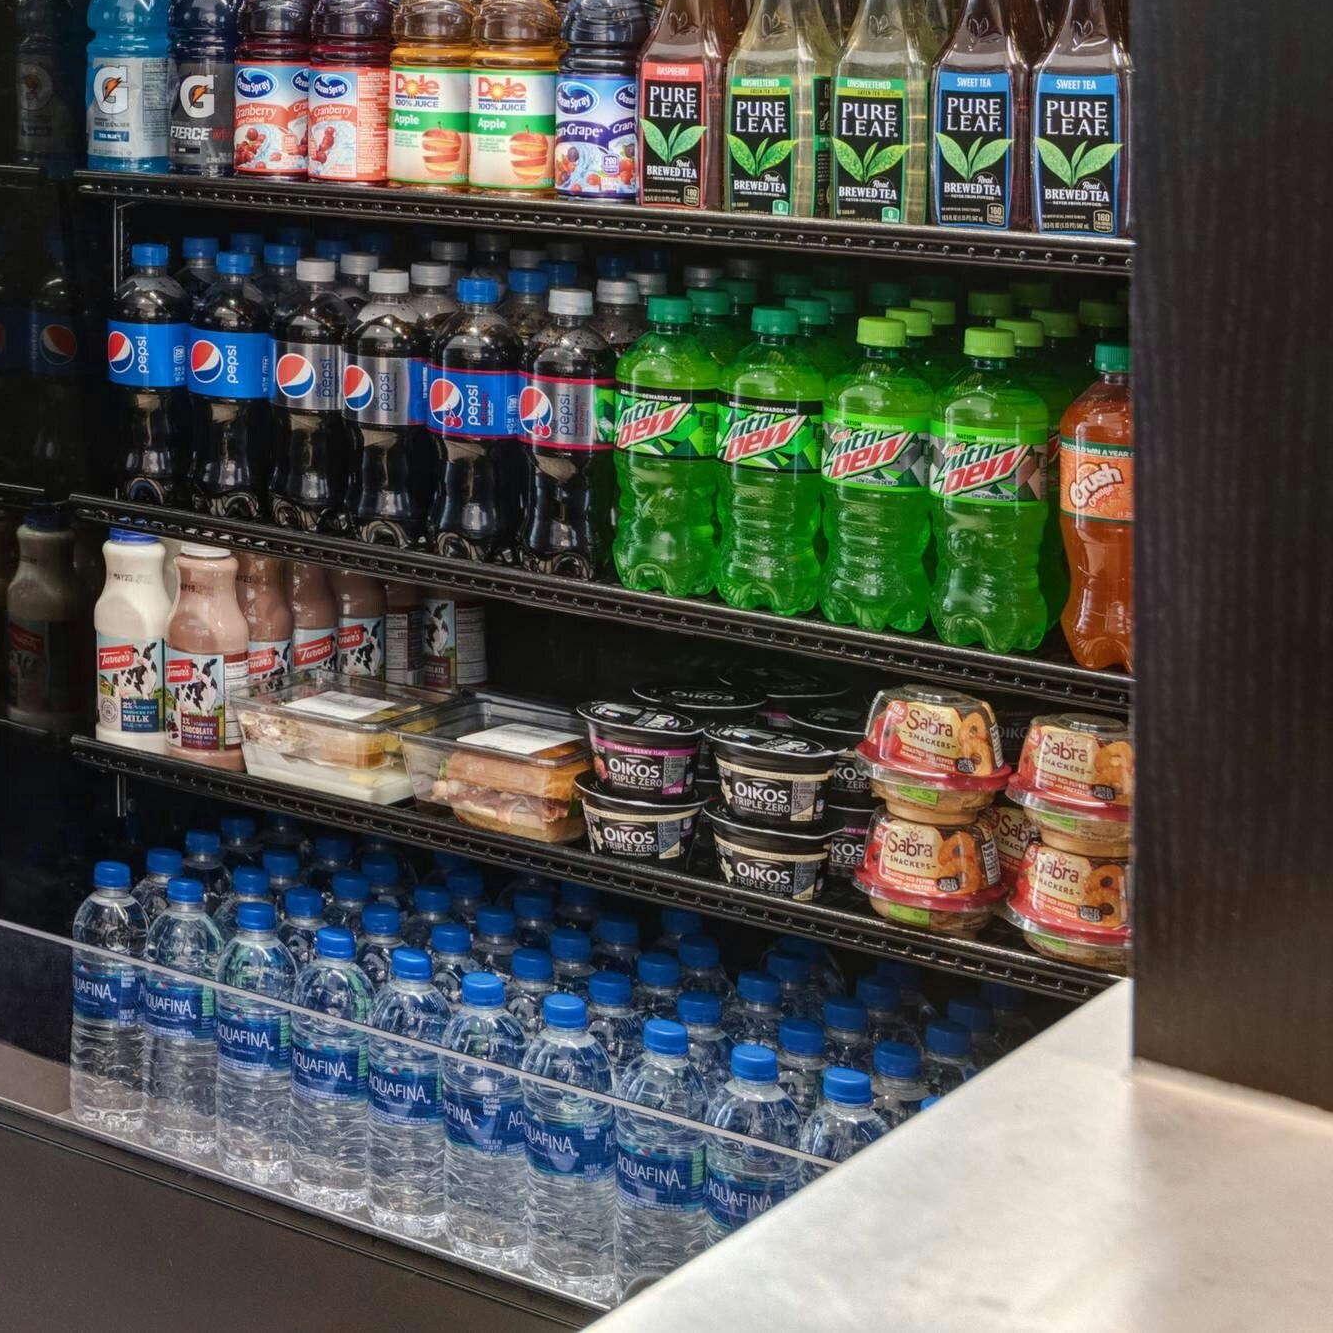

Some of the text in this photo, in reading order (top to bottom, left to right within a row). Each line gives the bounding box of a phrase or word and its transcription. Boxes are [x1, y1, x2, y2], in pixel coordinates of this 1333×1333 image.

[93, 64, 129, 115] G
[395, 73, 440, 96] Dole
[477, 76, 527, 99] Dole
[956, 78, 992, 88] SWEET TEA
[1056, 79, 1097, 91] SWEET TEA
[180, 74, 215, 119] G
[414, 99, 440, 108] JUICE
[649, 86, 697, 103] PURE
[235, 104, 277, 121] Cranberry
[313, 104, 352, 119] Cranberry
[498, 102, 526, 112] JUICE
[736, 100, 786, 117] PURE
[841, 102, 898, 120] PURE
[947, 98, 1001, 114] PURE
[1046, 100, 1108, 118] PURE
[394, 112, 420, 127] Apple
[477, 117, 507, 131] Apple
[170, 125, 210, 141] FIERCE
[646, 165, 698, 179] BREWED TEA
[733, 179, 787, 194] BREWED TEA
[838, 185, 898, 200] BREWED TEA
[943, 182, 1002, 196] BREWED TEA
[1044, 188, 1110, 203] BREWED TEA
[135, 336, 148, 374] pepsi
[225, 345, 239, 384] pepsi
[321, 359, 333, 398] pepsi
[380, 371, 391, 412] pepsi
[466, 384, 479, 426] pepsi
[558, 393, 571, 435] pepsi
[620, 402, 656, 427] Mtn
[730, 414, 772, 441] Mtn
[833, 431, 876, 459] Mtn
[947, 443, 993, 467] Mtn
[100, 650, 134, 667] Turner's
[300, 643, 335, 663] Turner's
[122, 714, 150, 724] MILK
[906, 708, 954, 737] Sabra
[181, 725, 214, 736] CHOCOLATE
[908, 731, 951, 750] SNACKERS
[1043, 734, 1089, 764] Sabra
[608, 757, 661, 779] OIKOS
[608, 772, 663, 789] TRIPLE ZERO
[735, 781, 789, 805] OIKOS
[734, 795, 791, 814] TRIPLE ZERO
[604, 823, 656, 845] OIKOS
[604, 840, 659, 854] TRIPLE ZERO
[888, 830, 934, 859] Sabra
[889, 853, 932, 872] SNACKERS
[736, 862, 791, 885] OIKOS
[735, 875, 793, 893] TRIPLE ZERO
[616, 1151, 682, 1188] AQUAFINA
